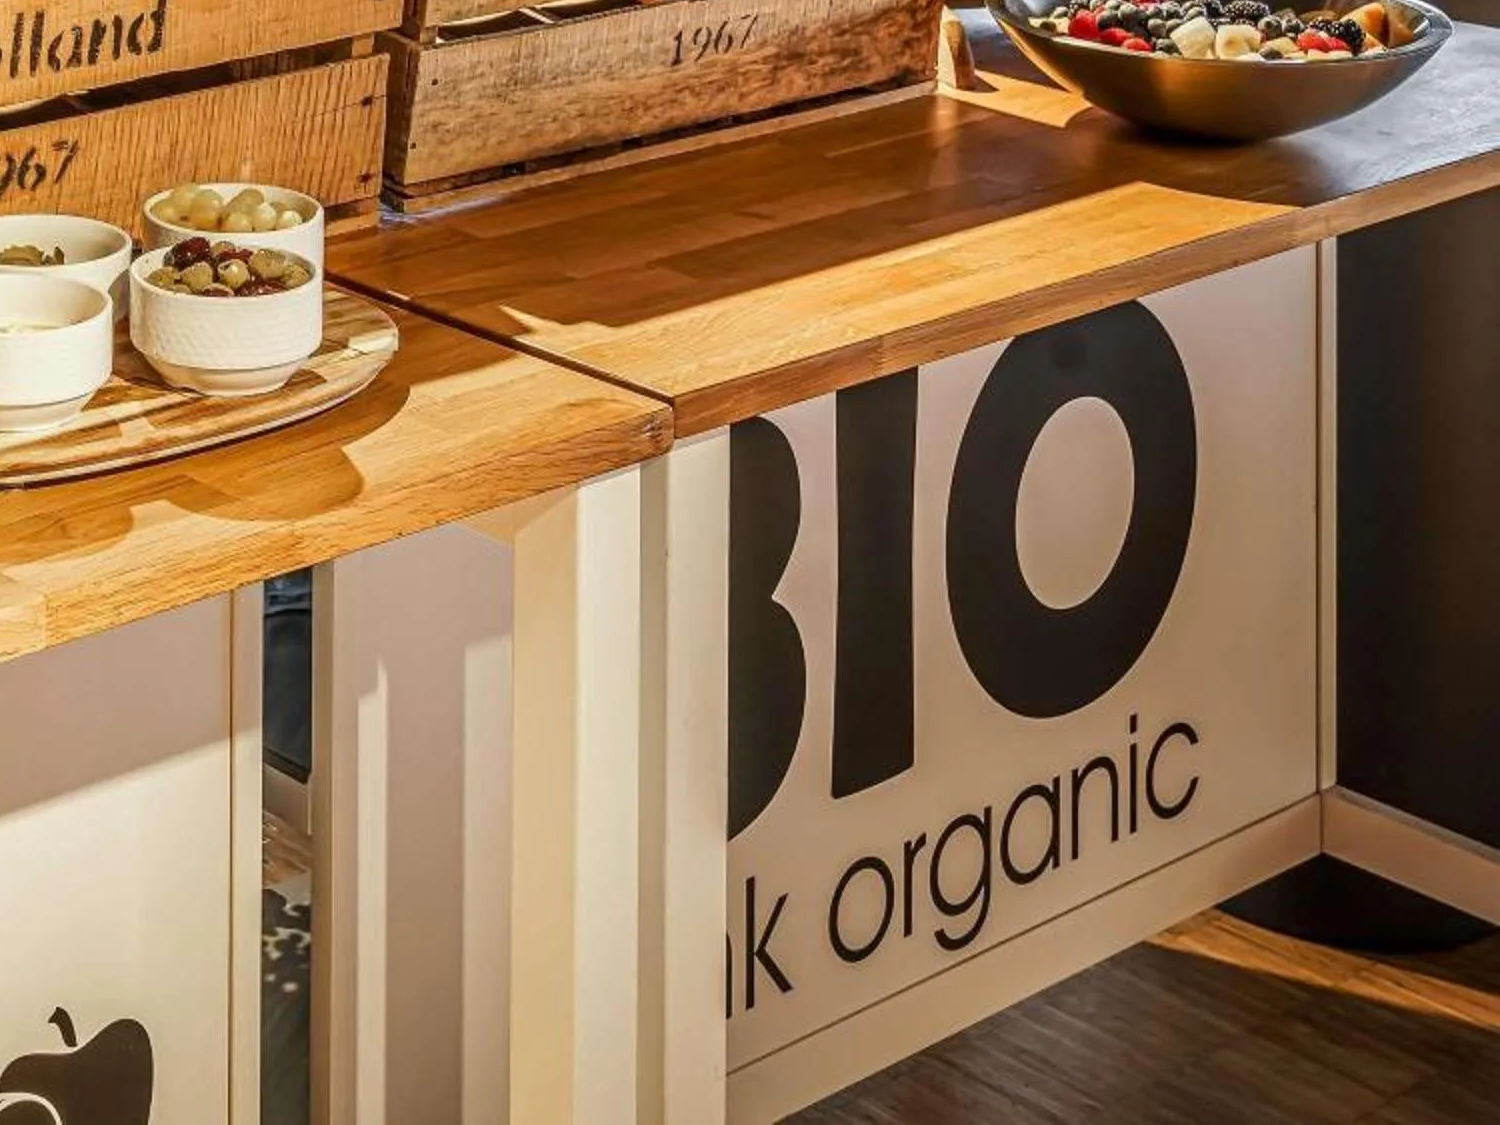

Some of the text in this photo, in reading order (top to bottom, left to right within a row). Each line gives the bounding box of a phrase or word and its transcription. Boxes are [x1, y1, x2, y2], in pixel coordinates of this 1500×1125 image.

[671, 14, 759, 66] 1967
[726, 714, 1201, 1019] k organic
